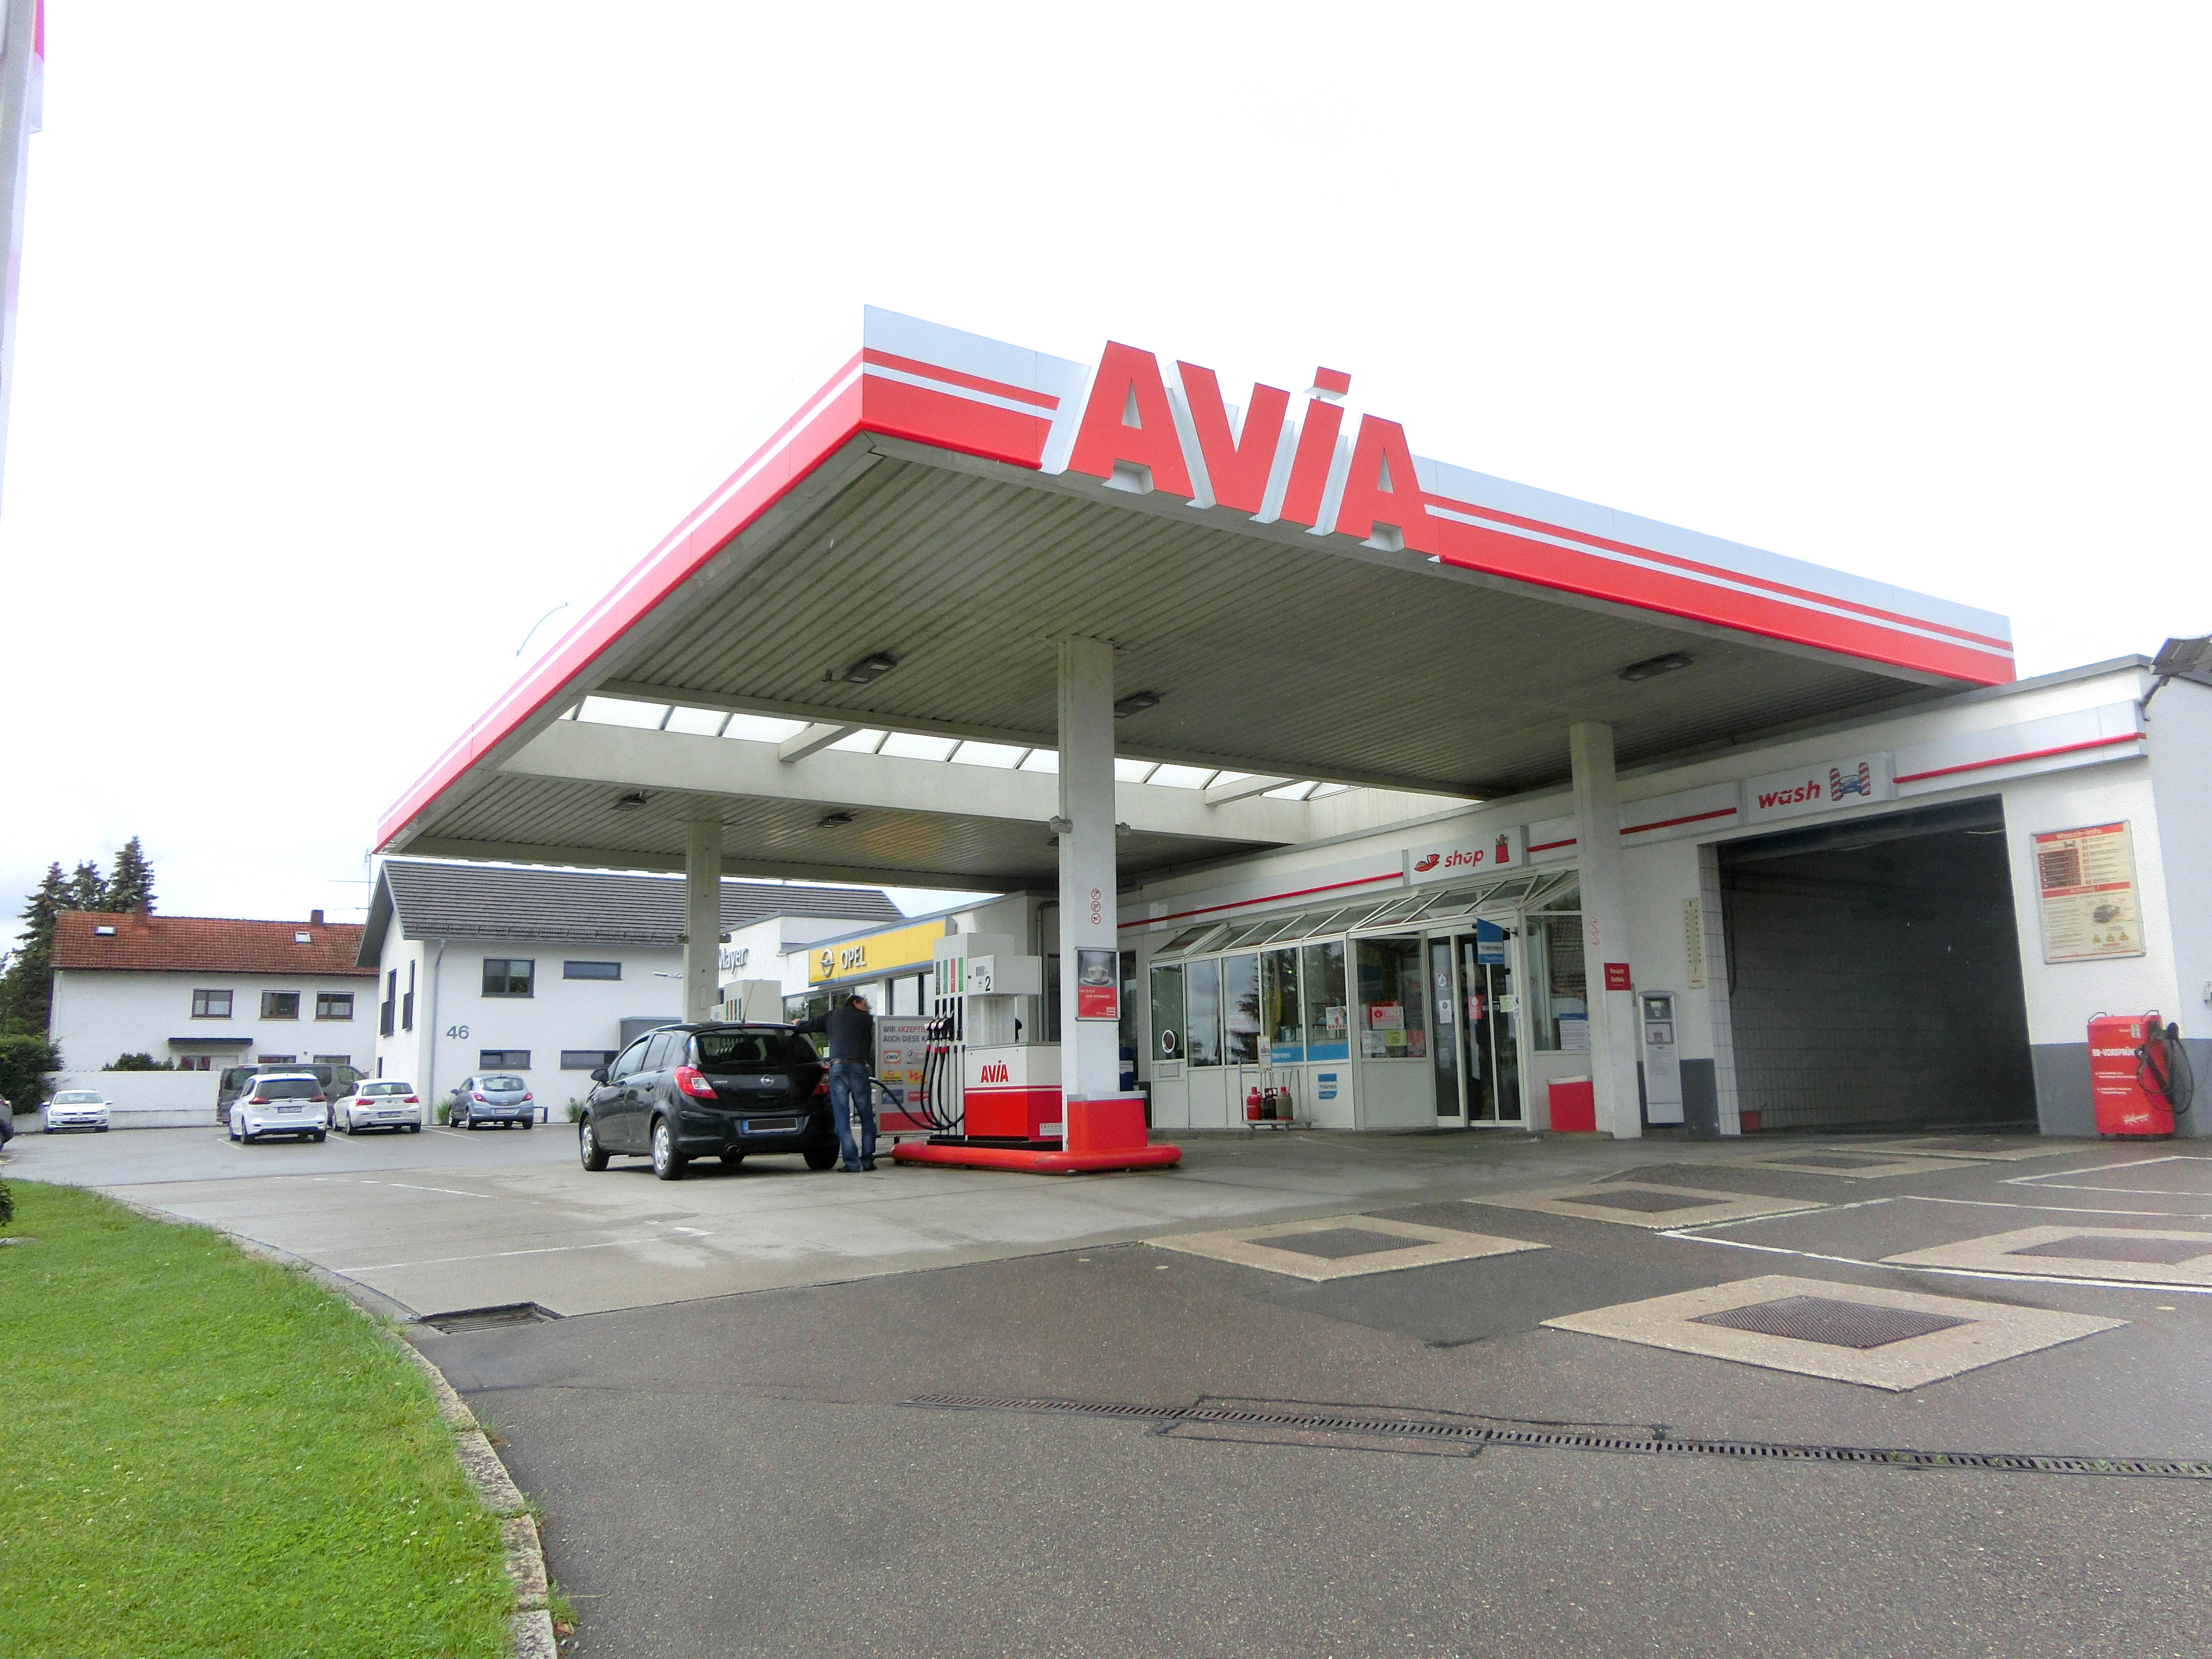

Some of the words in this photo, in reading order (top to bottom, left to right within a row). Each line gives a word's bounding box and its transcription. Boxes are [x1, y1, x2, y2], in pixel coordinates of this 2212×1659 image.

[1758, 780, 1820, 809] wash
[1444, 849, 1484, 867] shop
[841, 945, 867, 969] OPEL
[985, 975, 991, 992] 2
[446, 1025, 469, 1040] 46
